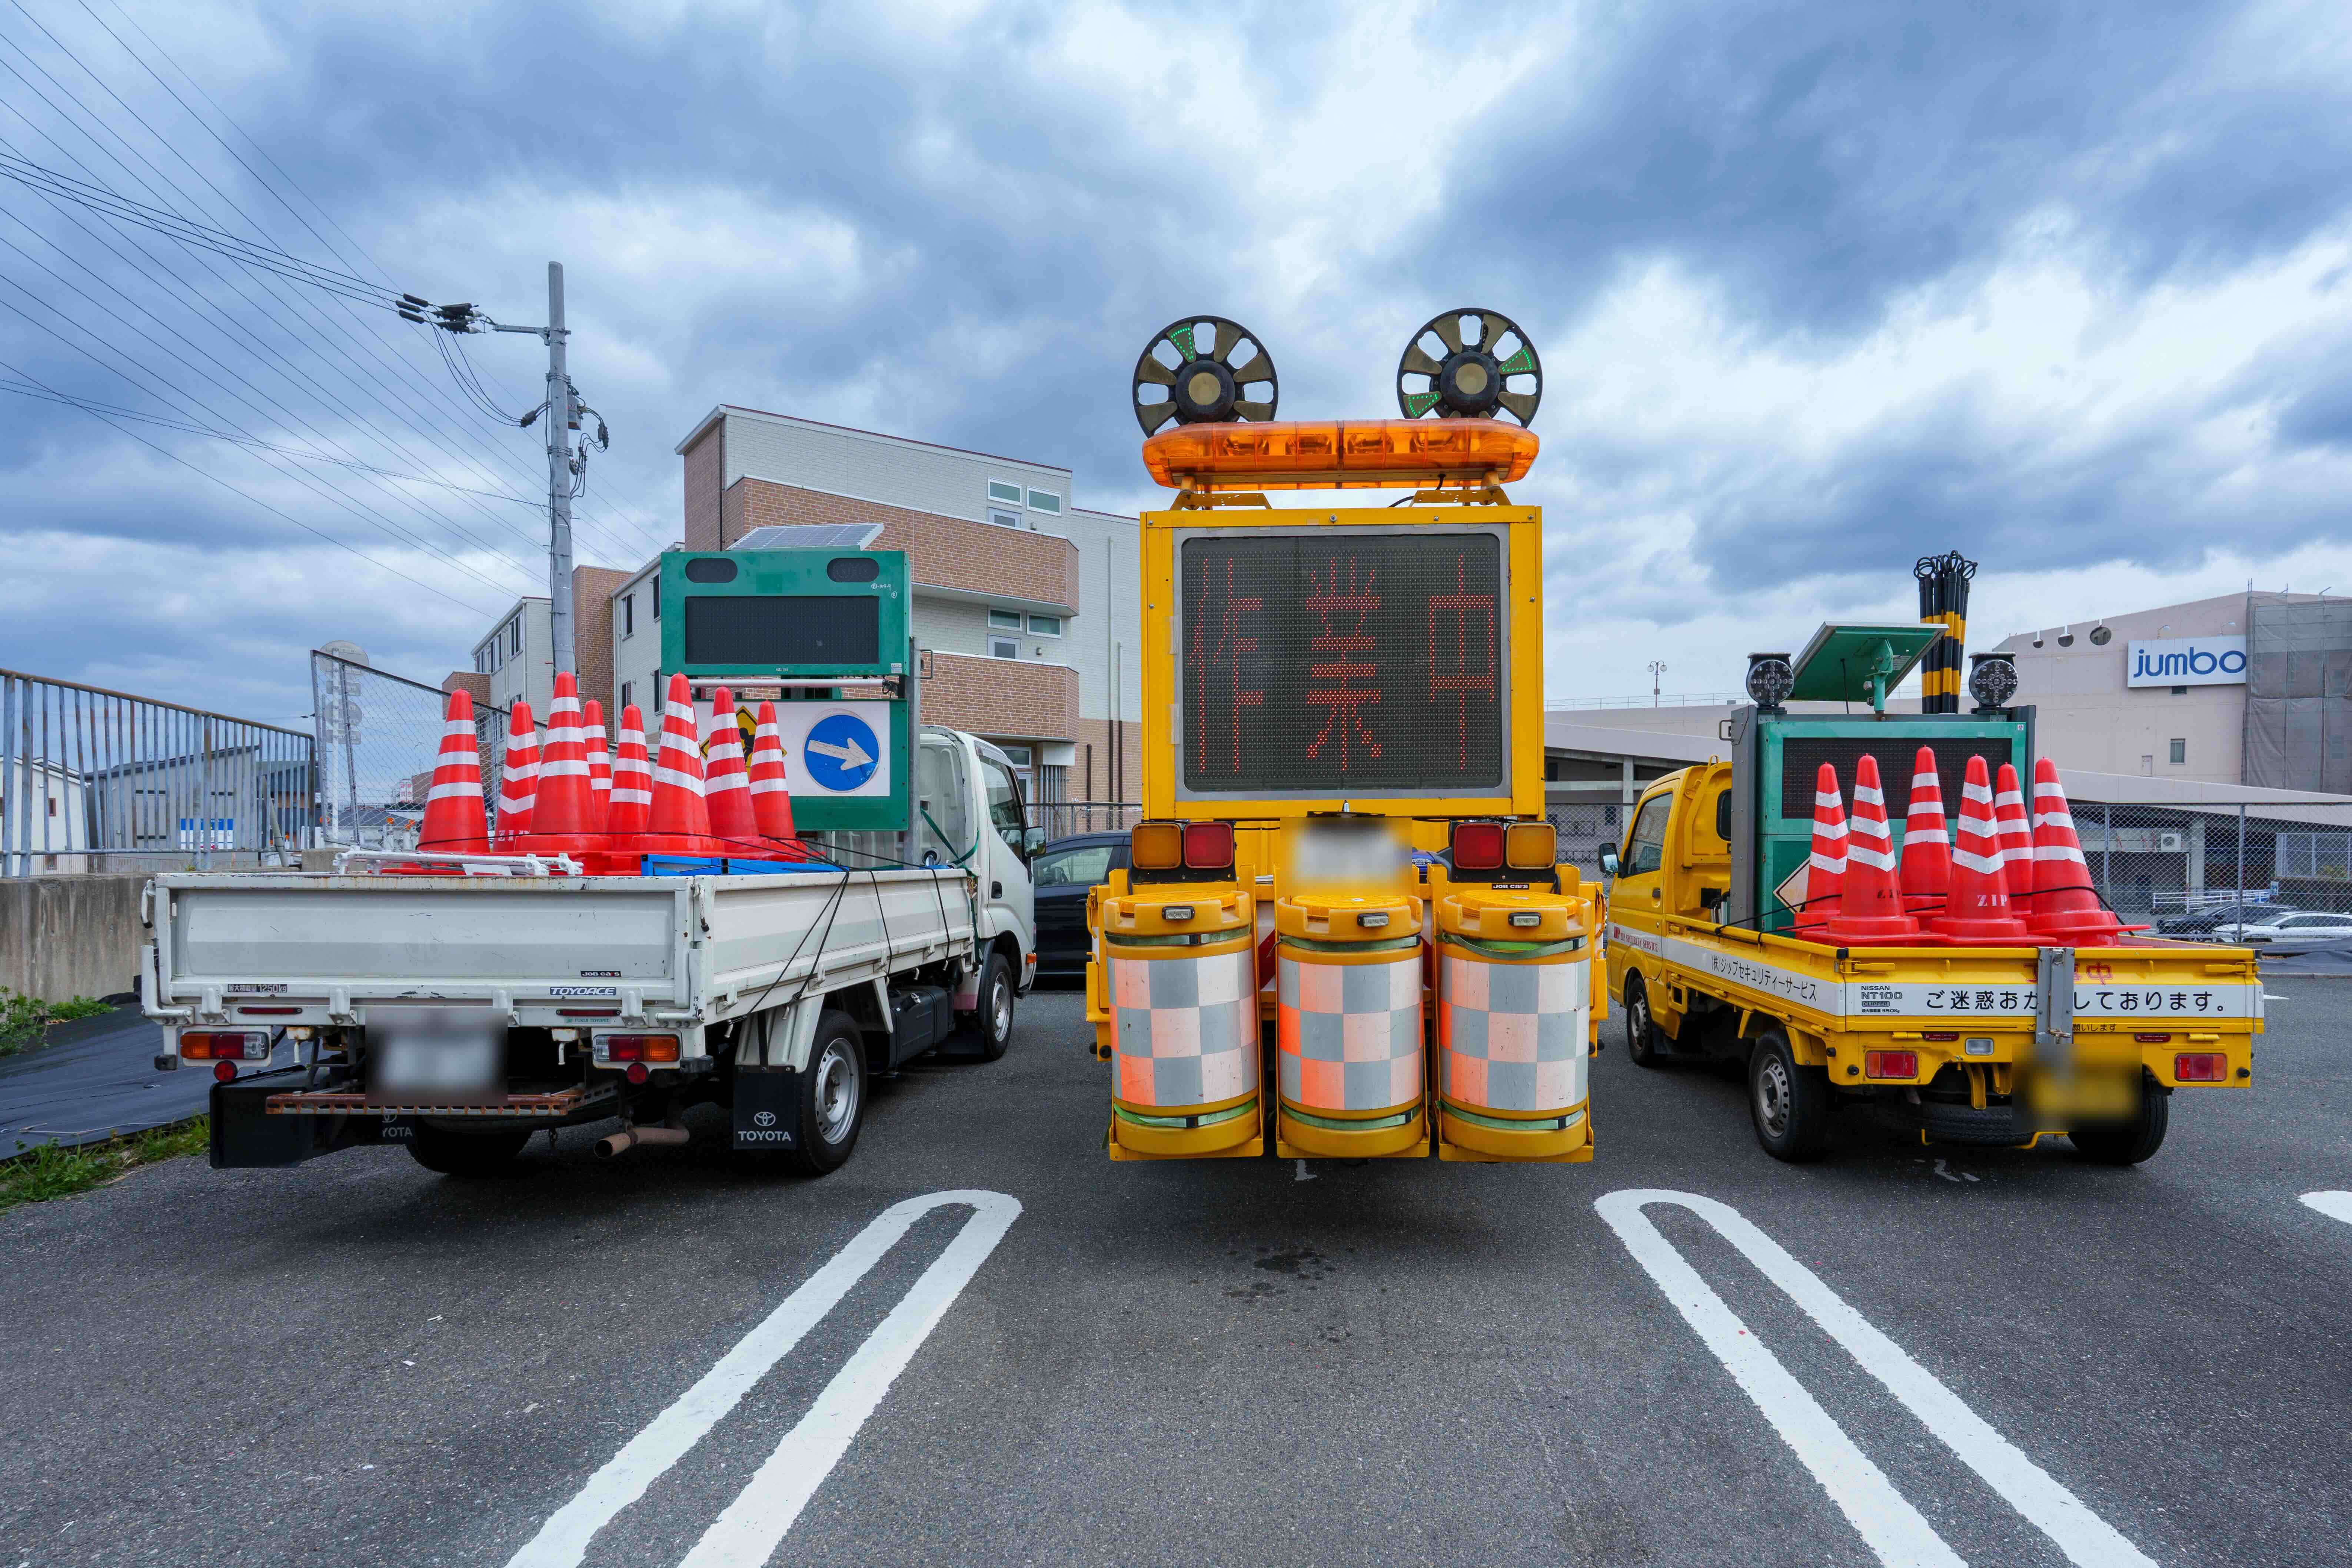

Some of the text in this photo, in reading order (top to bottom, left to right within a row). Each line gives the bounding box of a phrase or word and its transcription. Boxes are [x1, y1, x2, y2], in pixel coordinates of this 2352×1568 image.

[1187, 554, 1494, 773] 作業中
[2134, 647, 2247, 678] jumbo
[1977, 895, 2007, 906] ZIP
[1643, 939, 1659, 952] SERVICE
[1711, 954, 1817, 1001] (株)ジップセキュリティーサービス
[258, 984, 287, 992] 1250kg
[1926, 990, 2224, 1011] ご迷惑おかしております。
[2027, 1023, 2117, 1032] ご願いします
[382, 1127, 412, 1137] YOTA
[738, 1131, 791, 1141] TOYOTA
